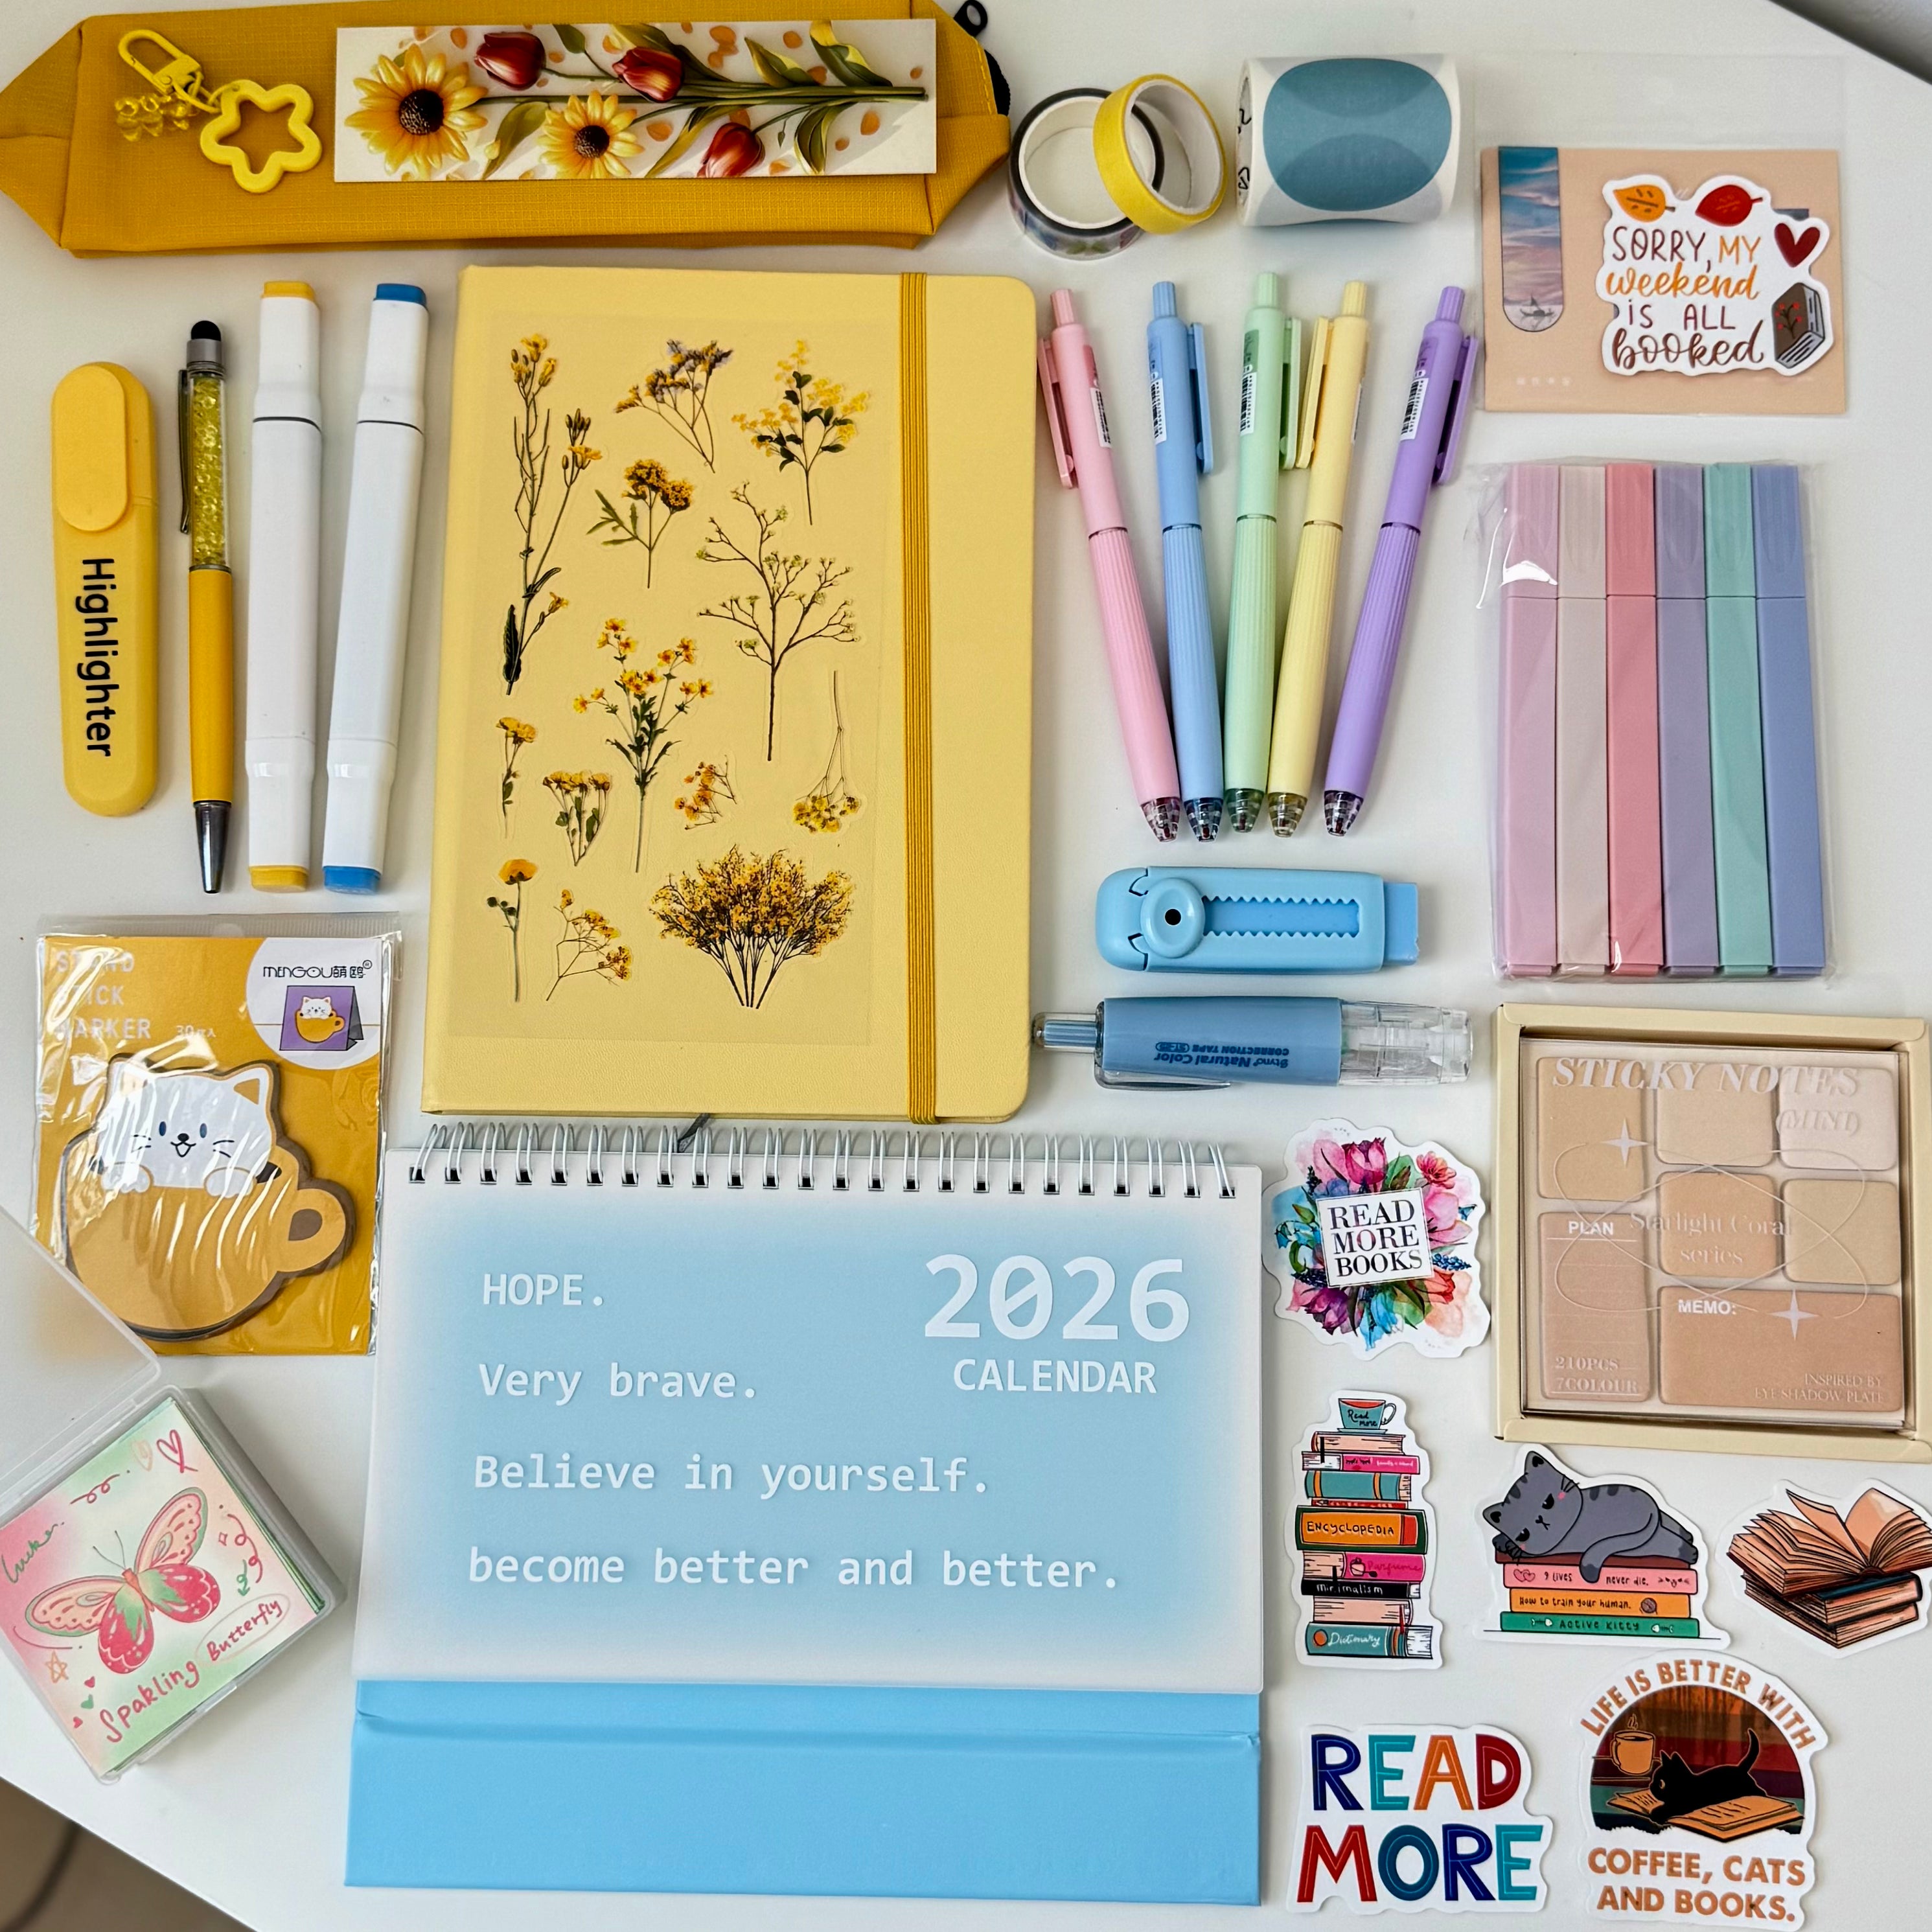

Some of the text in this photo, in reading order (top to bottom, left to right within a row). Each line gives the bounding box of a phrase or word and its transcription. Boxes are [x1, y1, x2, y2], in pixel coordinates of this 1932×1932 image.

[1612, 225, 1761, 272] SORRY, MY
[1605, 260, 1760, 300] weekend
[1683, 303, 1736, 330] ALL
[1612, 319, 1764, 369] booked
[75, 558, 119, 757] Highlighter
[1154, 1053, 1193, 1064] Color
[1192, 1044, 1218, 1053] TAPE
[1195, 1054, 1251, 1068] Natural
[1221, 1045, 1289, 1055] CORRECTION
[1552, 1057, 1858, 1096] STICKY NOTES
[1329, 1199, 1415, 1230] READ
[1568, 1220, 1614, 1236] PLAN
[1629, 1212, 1791, 1237] Starlight Coral
[1331, 1224, 1420, 1255] MORE
[1681, 1245, 1743, 1265] series
[1335, 1249, 1423, 1278] BOOKS
[483, 1273, 603, 1306] HOPE.
[925, 1254, 1190, 1342] 2026
[1678, 1299, 1737, 1315] MEMO:
[953, 1358, 1156, 1394] CALENDAR
[1555, 1356, 1619, 1371] 210PCS
[479, 1362, 755, 1406] Very brave.
[1555, 1377, 1639, 1394] 7COLOUR
[1782, 1388, 1840, 1401] SHADOW
[1846, 1391, 1884, 1403] PLATE
[1805, 1373, 1881, 1388] INSPIRED BY
[1348, 1409, 1369, 1423] Read
[474, 1453, 986, 1499] Believe in yourself.
[1307, 1521, 1394, 1535] ENCYCLOPEDIA
[469, 1546, 1116, 1589] become better and better.
[1544, 1571, 1549, 1580] 9
[1606, 1576, 1629, 1585] never
[1633, 1576, 1648, 1586] die.
[1519, 1596, 1536, 1605] How
[1552, 1597, 1573, 1606] train
[1576, 1598, 1596, 1607] your
[1600, 1599, 1631, 1609] human.
[207, 1600, 283, 1661] Butterfly
[100, 1661, 200, 1742] Spakling
[1580, 1659, 1817, 1750] LIFE IS BETTER WITH
[1311, 1734, 1522, 1811] READ
[1296, 1823, 1544, 1903] MORE
[1588, 1847, 1806, 1886] COFFEE, CATS
[1596, 1885, 1796, 1922] AND BOOKS.
